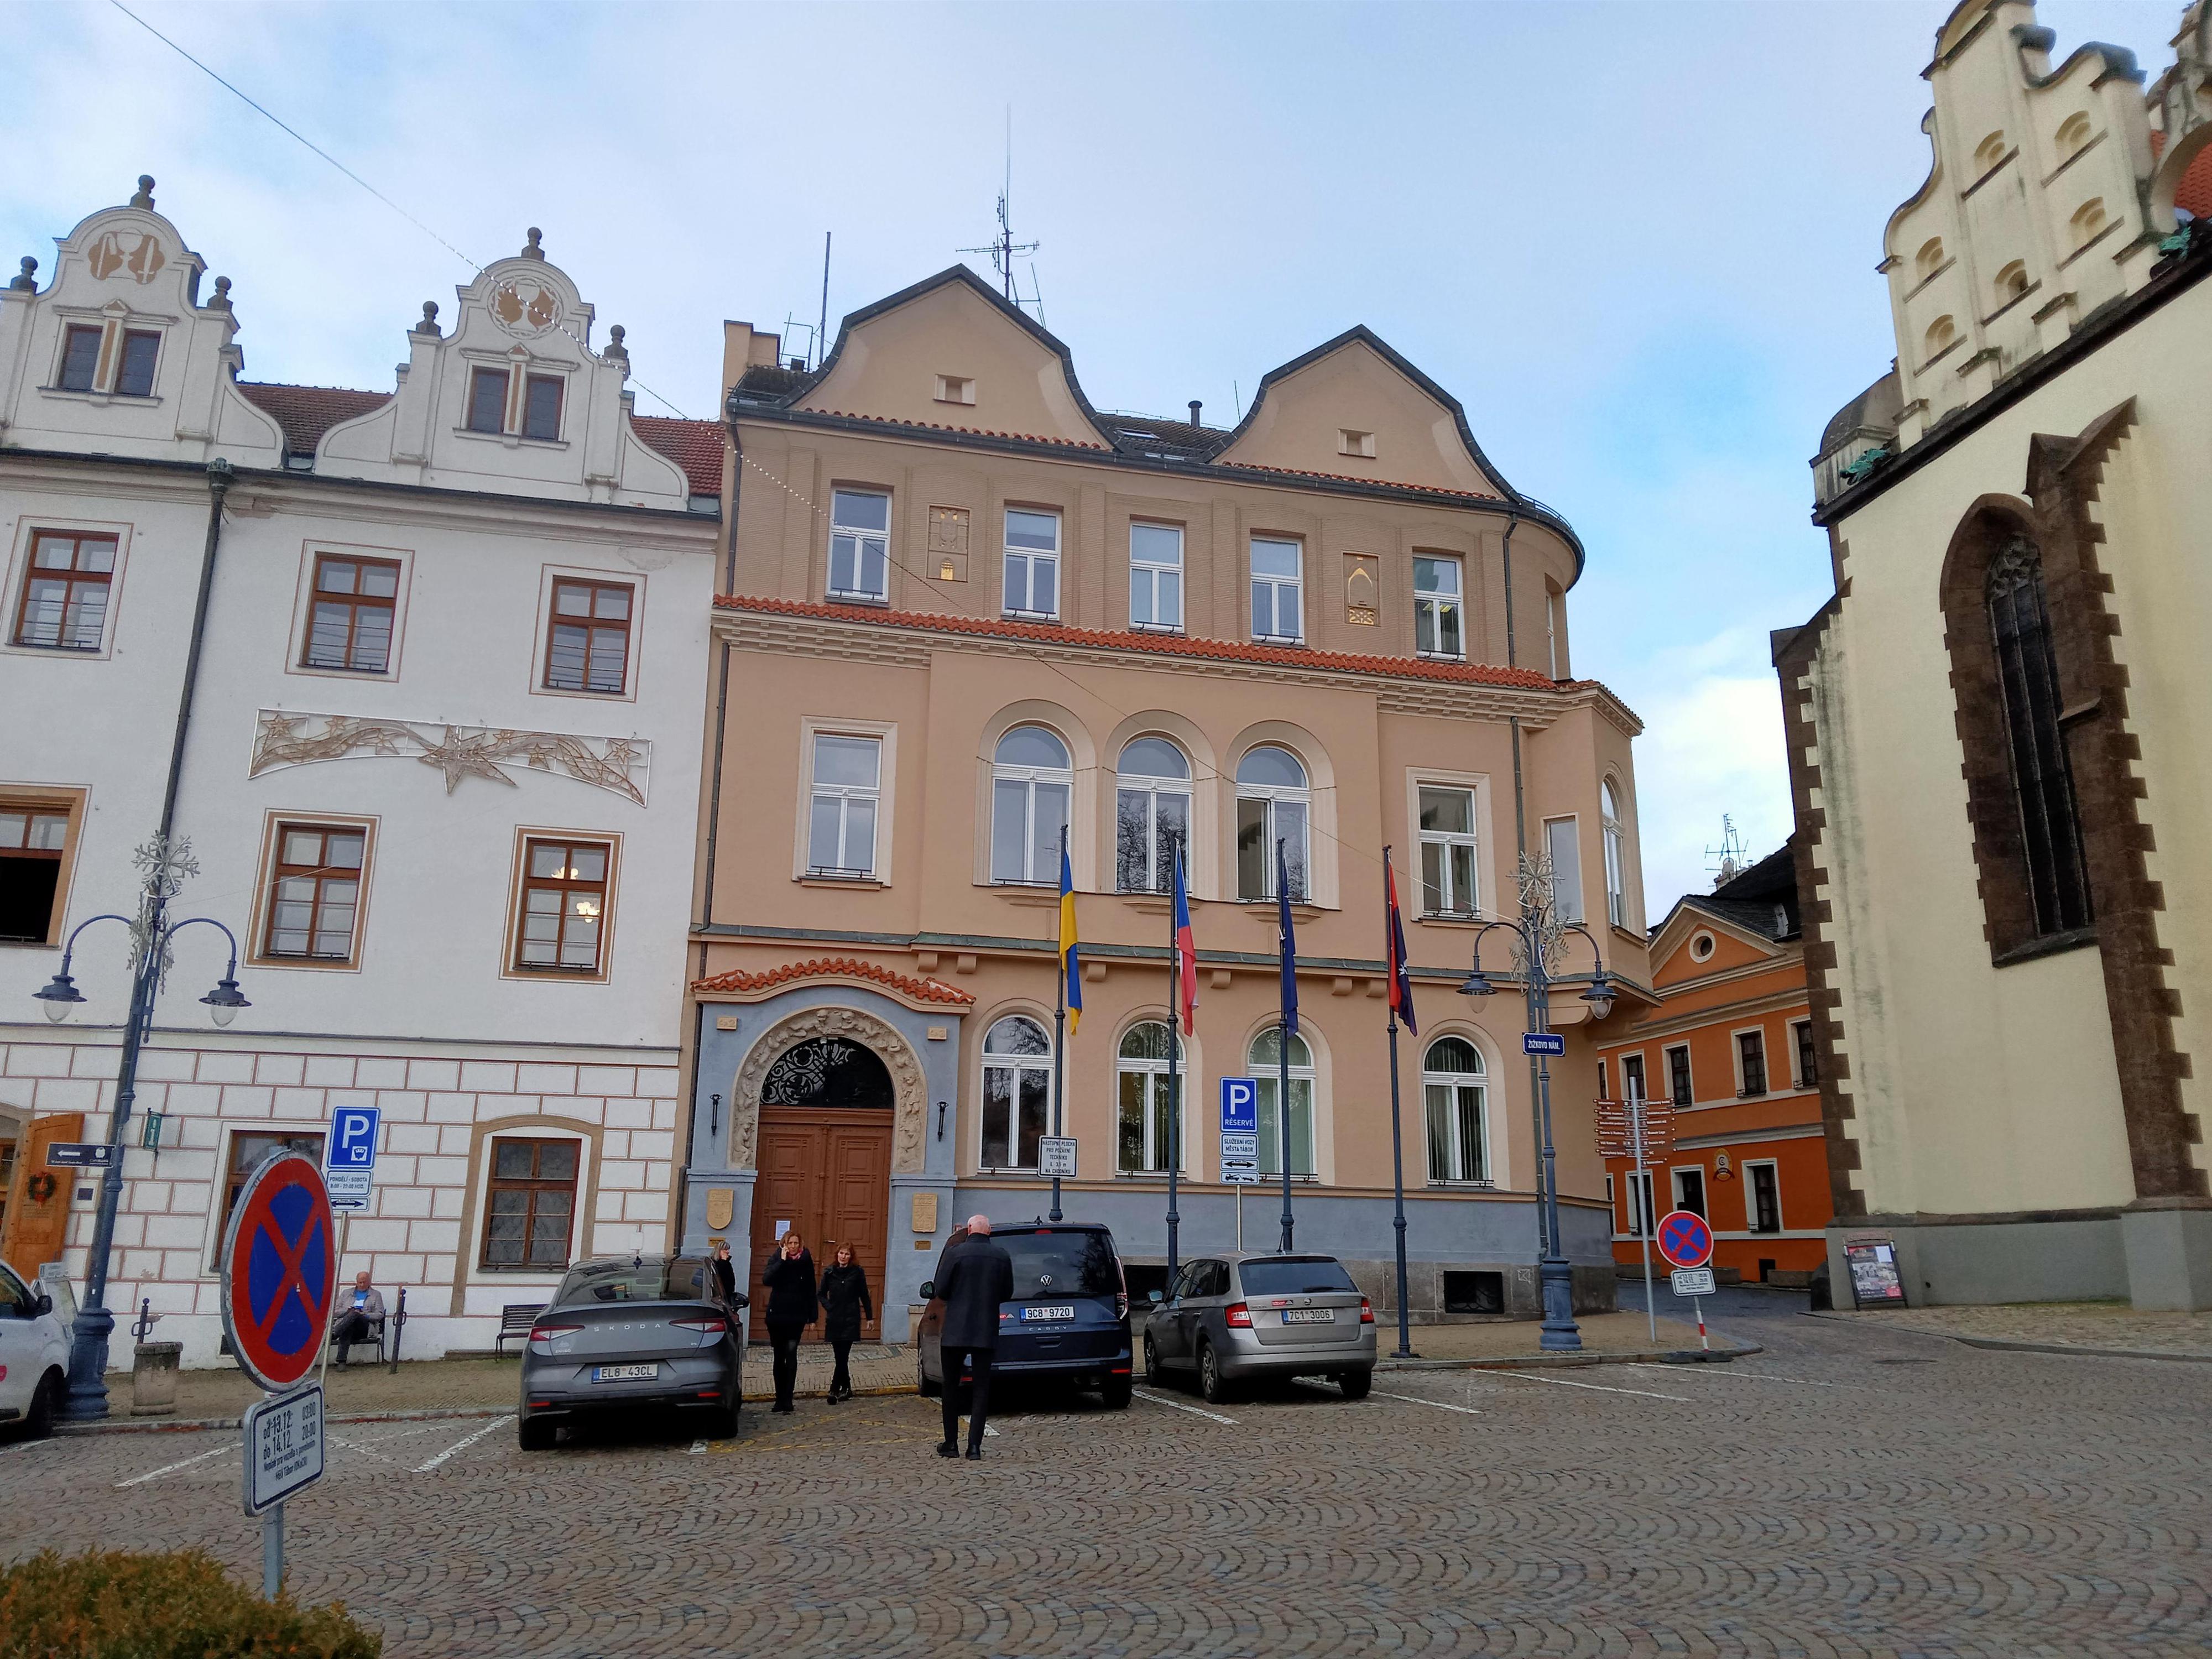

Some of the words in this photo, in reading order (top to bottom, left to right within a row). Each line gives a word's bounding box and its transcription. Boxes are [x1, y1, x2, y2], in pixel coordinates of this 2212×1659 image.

[1528, 1039, 1547, 1049] ŽIŽKOVO
[1548, 1040, 1561, 1050] NÁM.
[1230, 1084, 1250, 1115] P
[1224, 1117, 1254, 1126] RÉSERVÉ
[342, 1115, 369, 1149] P
[1027, 1309, 1043, 1318] 9C8
[1049, 1308, 1070, 1317] 9720
[1289, 1311, 1305, 1320] 7C1
[1310, 1310, 1330, 1319] 3006
[601, 1368, 620, 1378] EL8
[628, 1366, 653, 1376] 43CL
